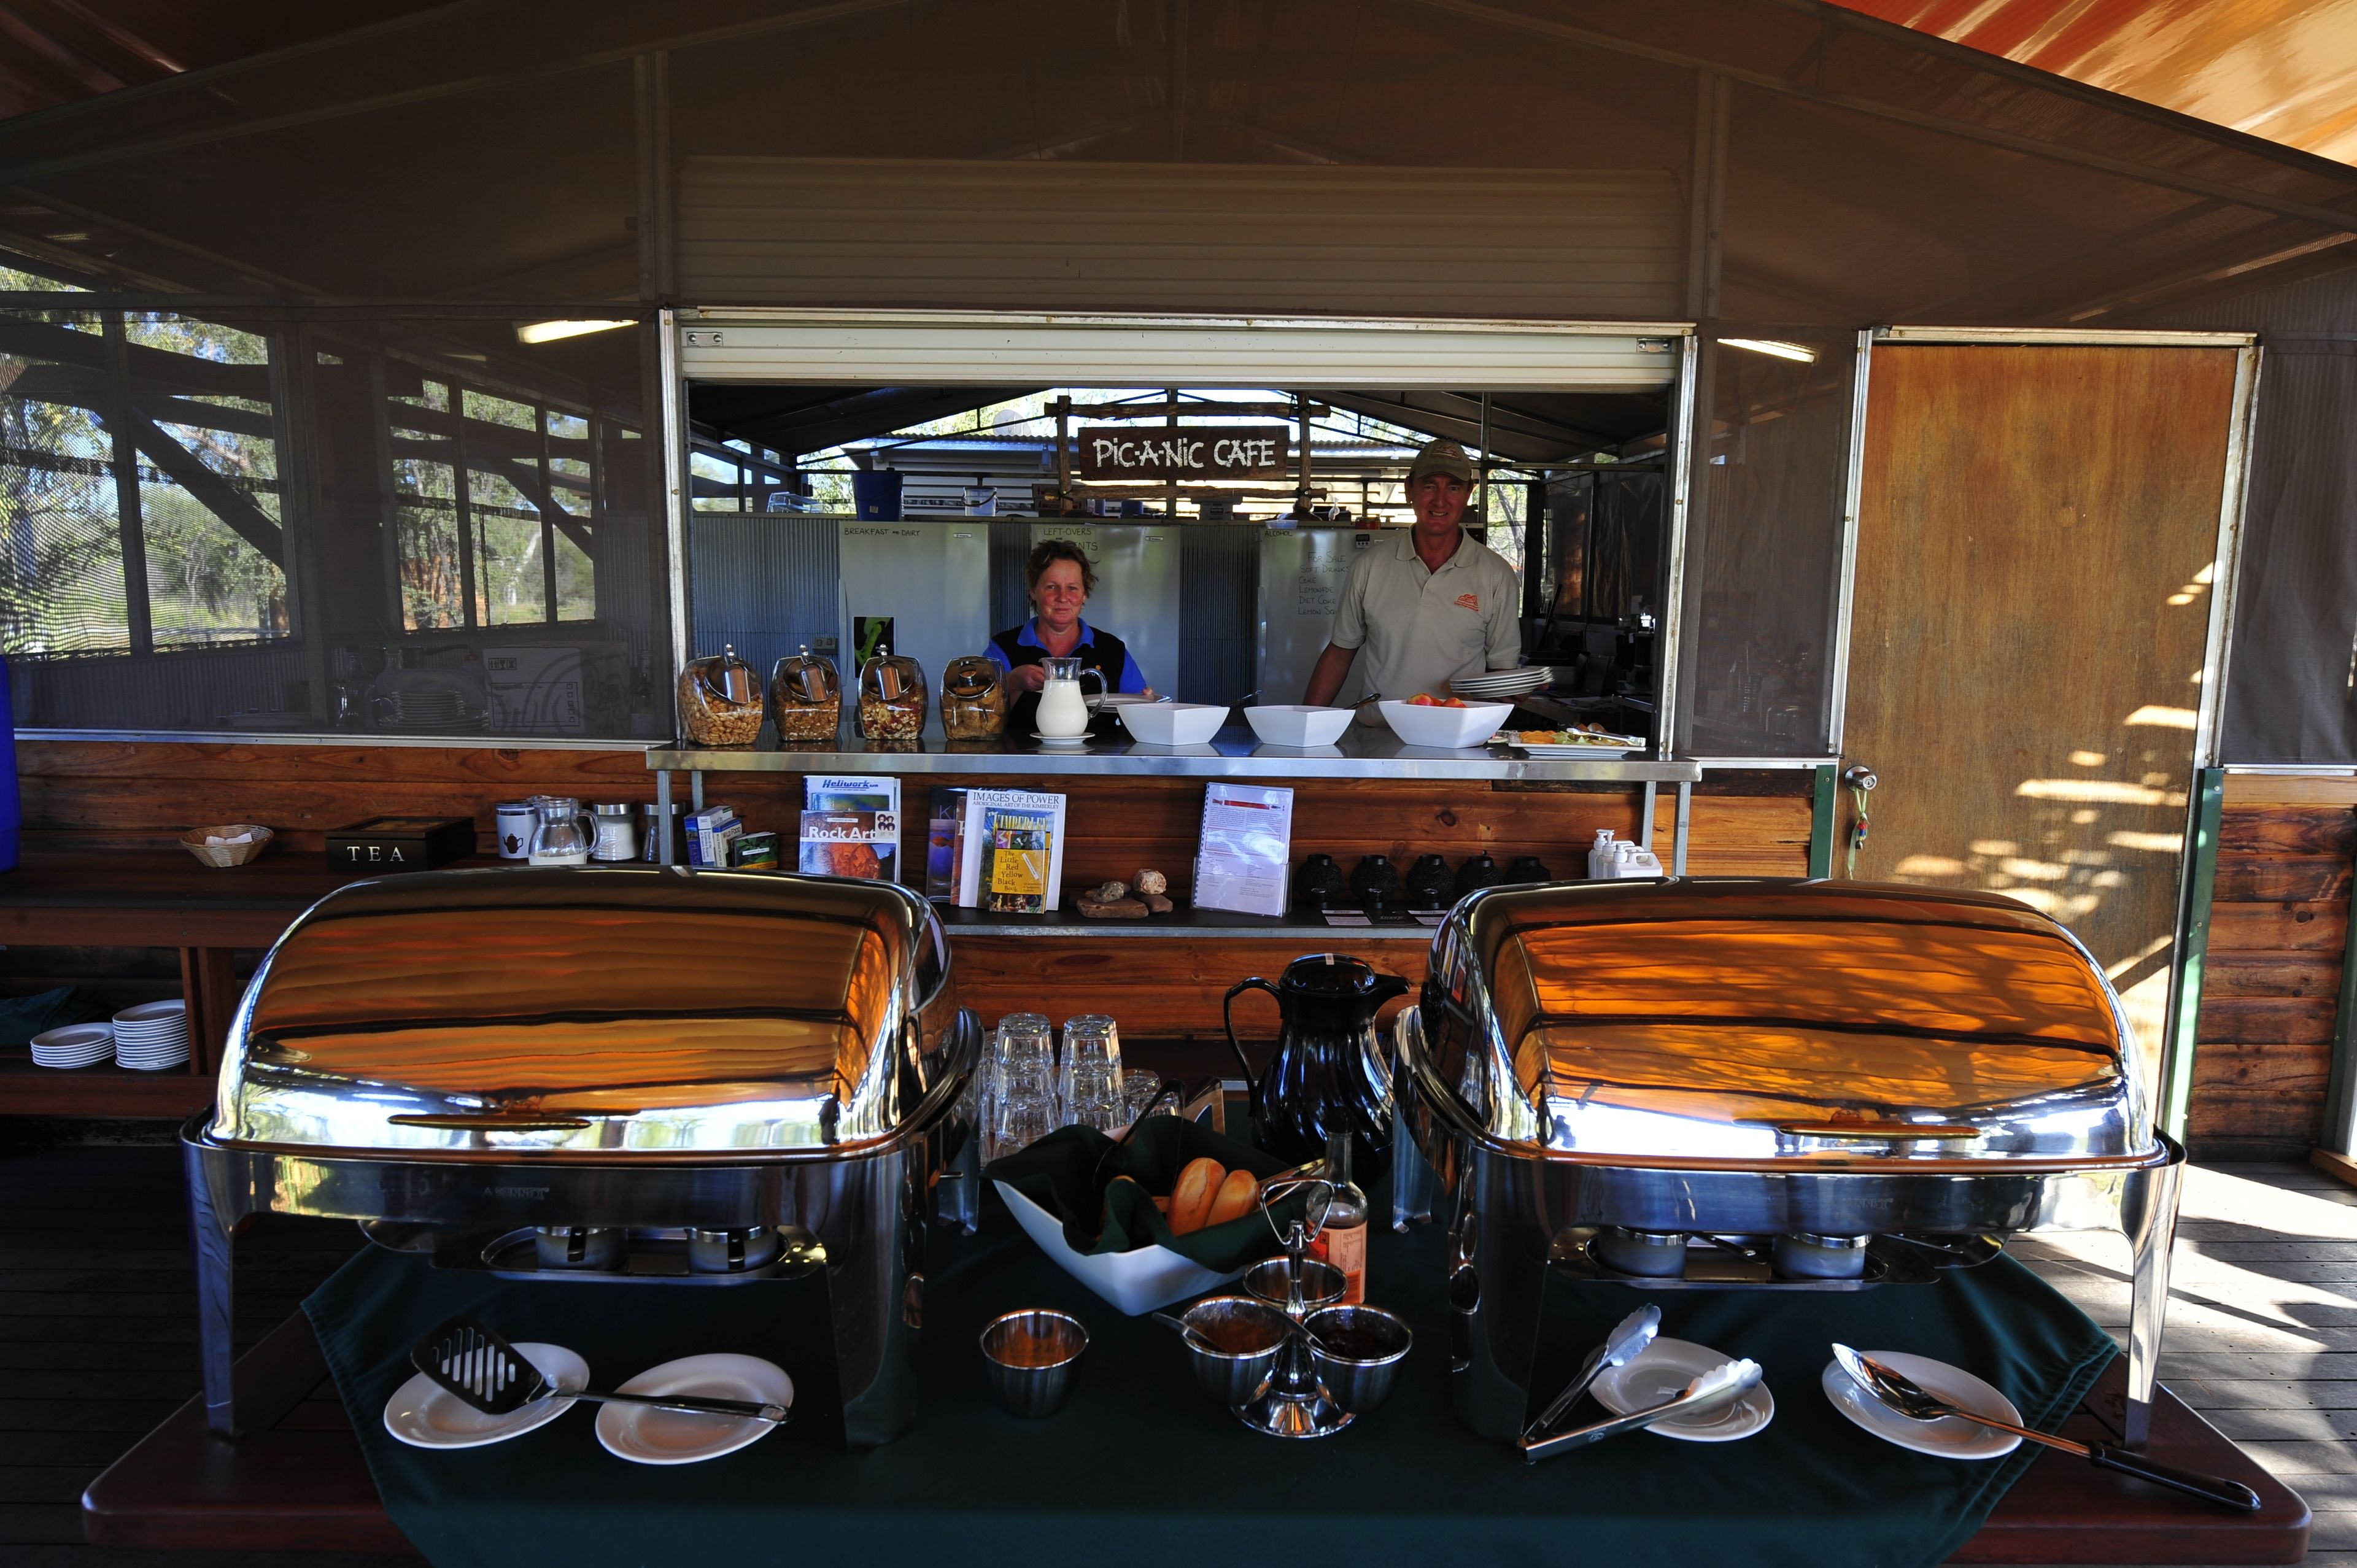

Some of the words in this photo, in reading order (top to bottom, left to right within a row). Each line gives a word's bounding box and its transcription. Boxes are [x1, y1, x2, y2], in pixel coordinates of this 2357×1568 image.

[1213, 439, 1275, 468] CAFE
[1308, 552, 1322, 563] FOR
[1326, 551, 1345, 563] SALE
[1323, 565, 1350, 573] DRINKS
[1299, 585, 1334, 593] LEMONADE
[1318, 595, 1336, 604] COKE
[822, 779, 870, 789] Heliwork
[973, 792, 1010, 802] IMAGES
[1012, 794, 1025, 803] OF
[1026, 795, 1059, 804] POWER
[993, 814, 1047, 833] KIMBERLEY
[808, 826, 847, 839] Rock
[850, 827, 876, 839] Art
[347, 846, 405, 862] TEA
